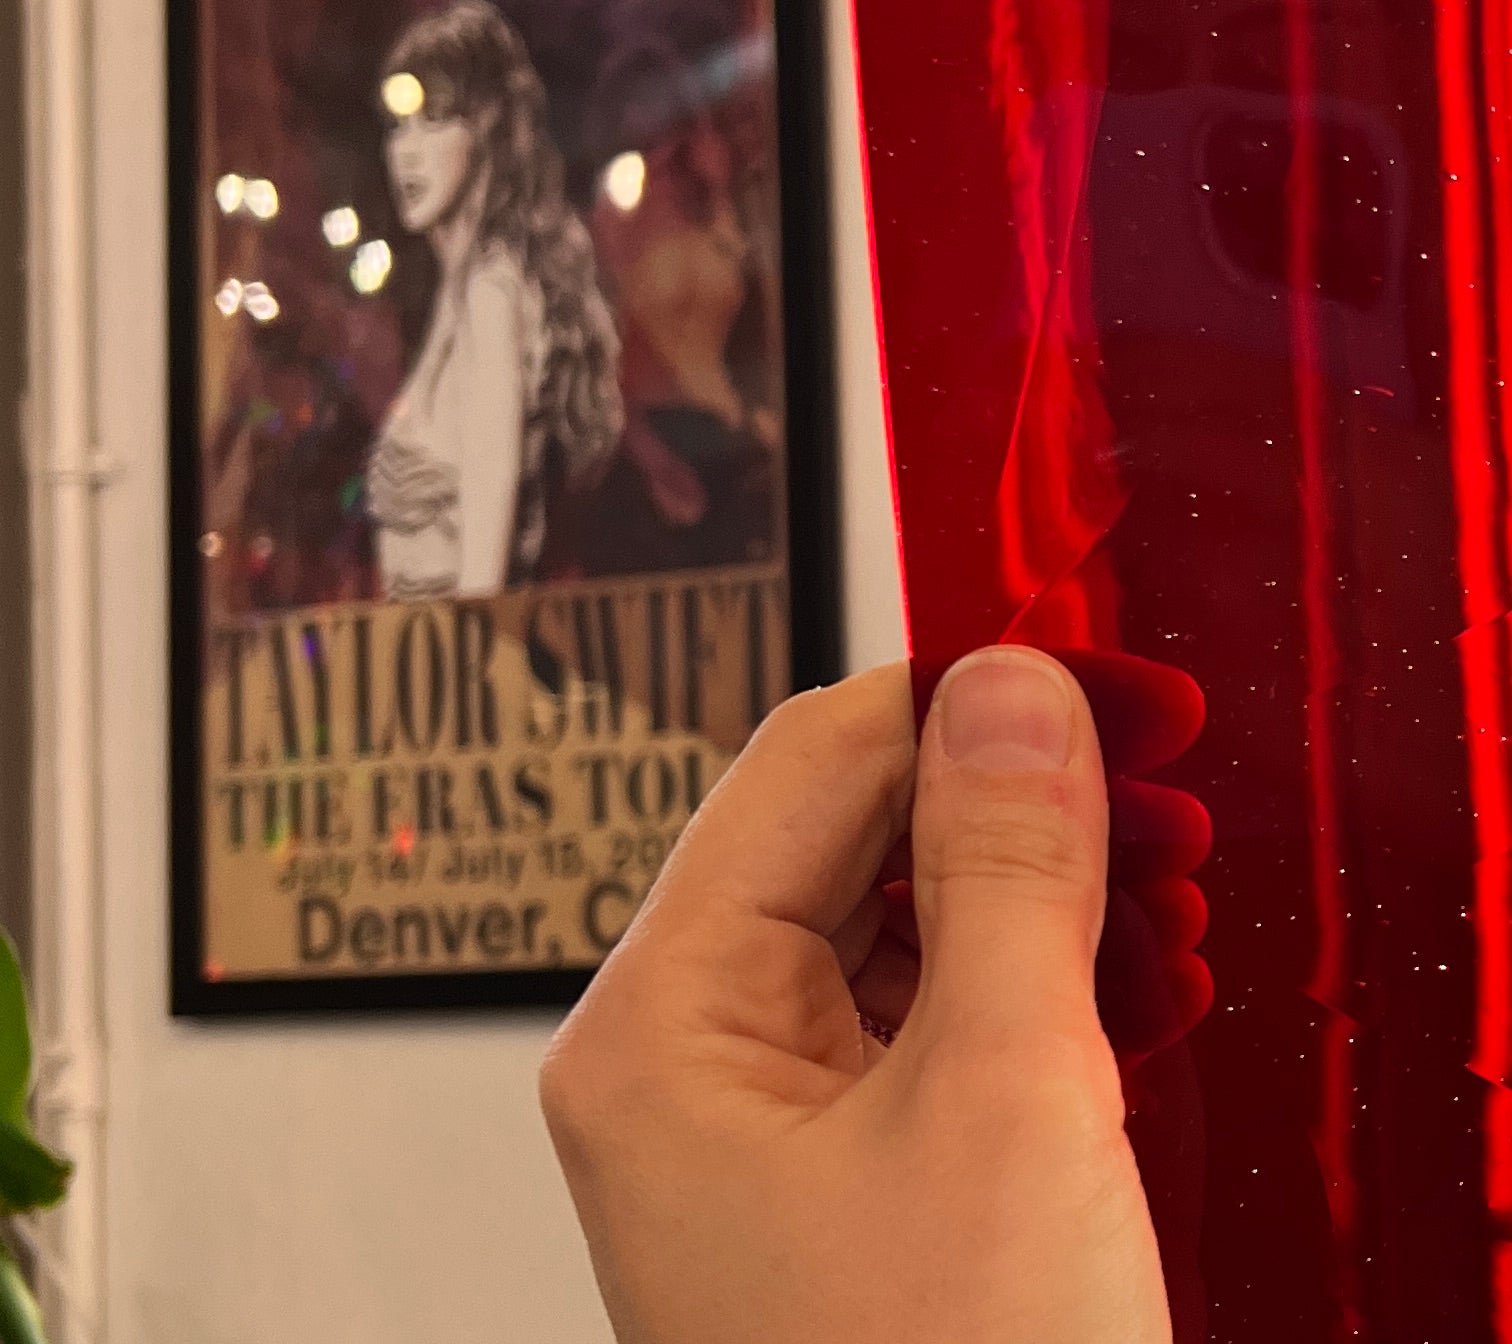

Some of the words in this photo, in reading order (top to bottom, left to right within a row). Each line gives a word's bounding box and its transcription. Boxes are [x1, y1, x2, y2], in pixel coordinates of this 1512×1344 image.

[210, 601, 500, 764] TAYLOR
[522, 580, 788, 744] SWIFT
[216, 776, 352, 849] THE
[370, 758, 554, 835] ERAS
[442, 842, 526, 891] July
[299, 893, 560, 971] Denver,
